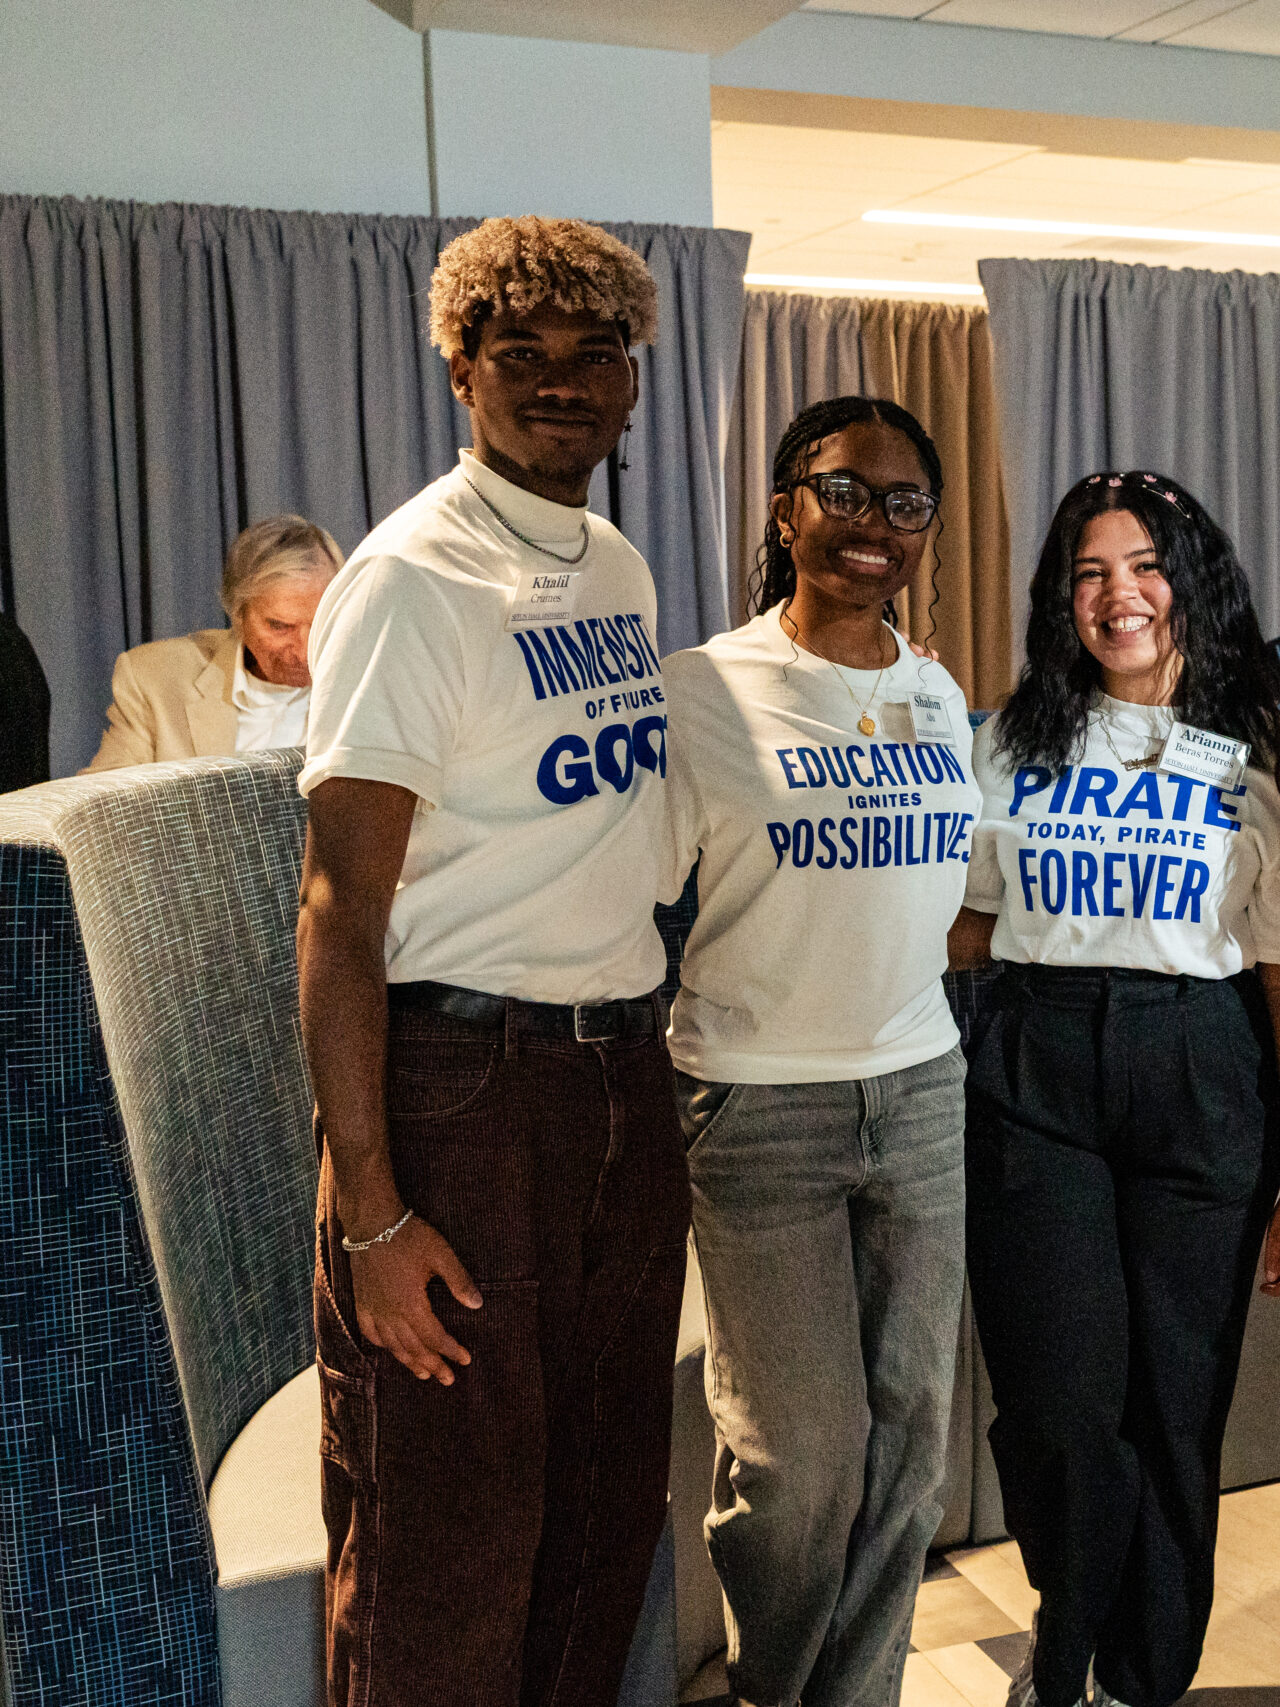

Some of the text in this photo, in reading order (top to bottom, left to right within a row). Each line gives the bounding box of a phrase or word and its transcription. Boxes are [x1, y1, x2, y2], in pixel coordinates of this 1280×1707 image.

[532, 574, 571, 589] Khalil
[513, 613, 662, 701] IMMENSIT
[585, 698, 606, 720] OF
[913, 694, 942, 711] Shalom
[1175, 742, 1235, 769] Beras Torres
[1180, 728, 1238, 756] Arianni
[775, 743, 967, 790] EDUCATION
[848, 792, 922, 809] IGNITES
[1008, 765, 1247, 832] PIRATE
[1027, 822, 1206, 850] TODAY, PIRATE
[1018, 848, 1210, 923] FOREVER
